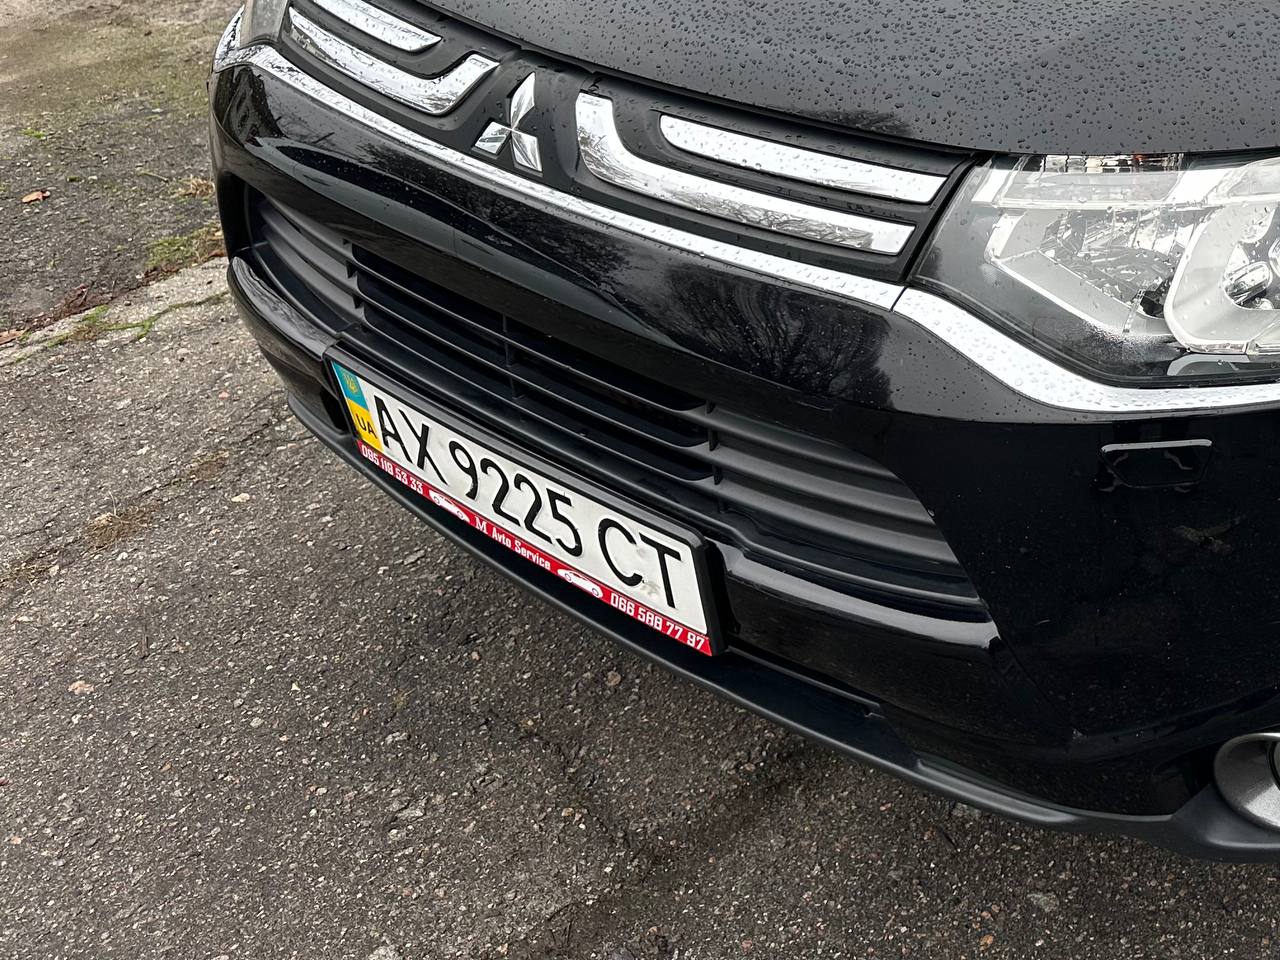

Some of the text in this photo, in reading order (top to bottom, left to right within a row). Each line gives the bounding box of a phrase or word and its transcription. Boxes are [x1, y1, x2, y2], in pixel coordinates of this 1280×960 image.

[355, 413, 378, 439] UA
[374, 395, 683, 609] AX 9225 CT
[361, 444, 380, 466] 095
[394, 467, 409, 486] 53
[409, 476, 424, 495] 33
[475, 515, 488, 535] M
[492, 527, 512, 547] Avto
[514, 539, 551, 571] Service
[610, 592, 635, 616] 066
[637, 607, 663, 633] 588
[665, 621, 683, 641] 77
[686, 631, 705, 651] 97
